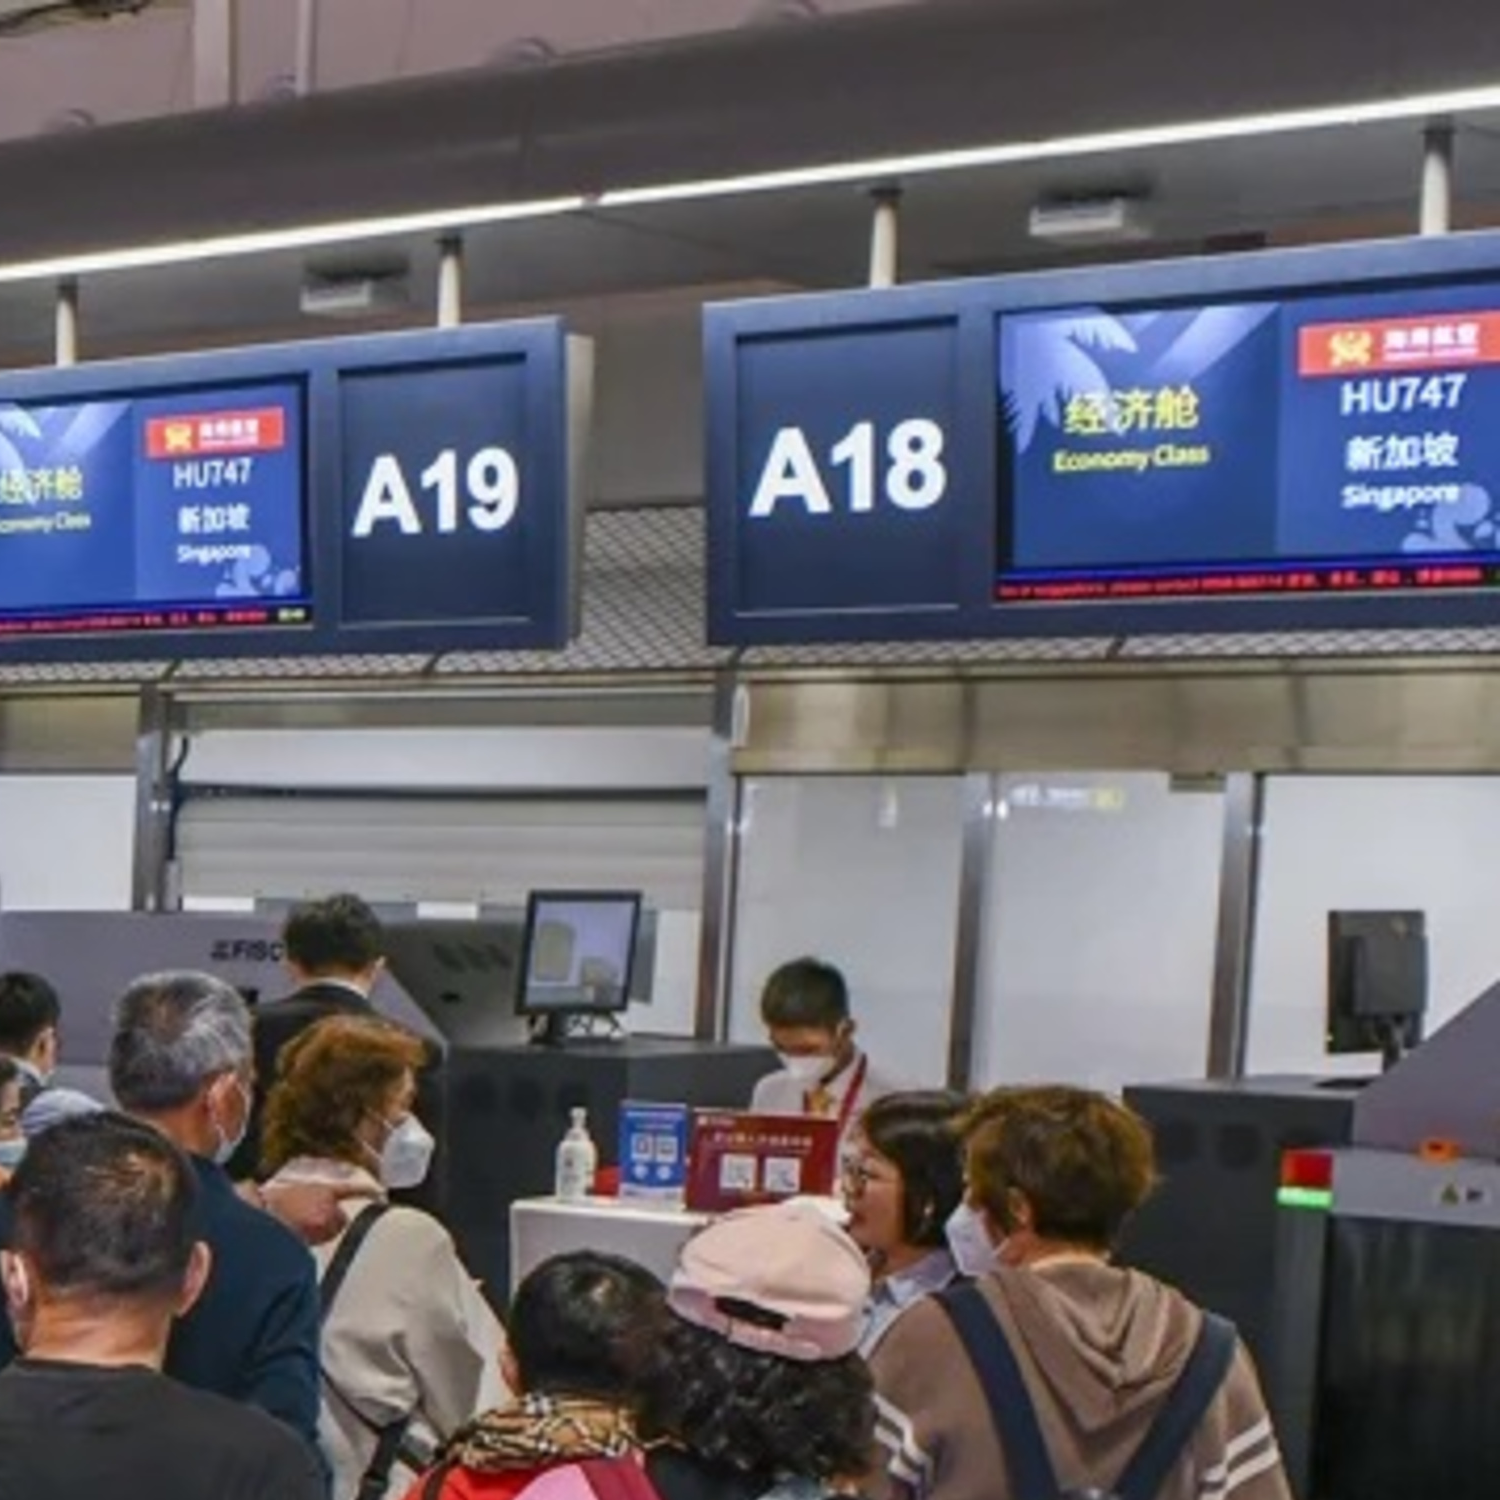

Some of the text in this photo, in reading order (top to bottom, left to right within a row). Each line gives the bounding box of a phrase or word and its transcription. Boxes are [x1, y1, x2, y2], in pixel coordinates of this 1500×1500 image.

[1064, 385, 1199, 435] 经济舱
[1341, 373, 1467, 415] HU747
[749, 418, 947, 518] A18
[1053, 443, 1210, 473] Economy Class
[1346, 432, 1459, 471] 新加坡
[173, 458, 252, 489] HU747
[351, 447, 520, 537] A19
[1341, 482, 1461, 510] Singapore
[233, 940, 285, 961] FISC
